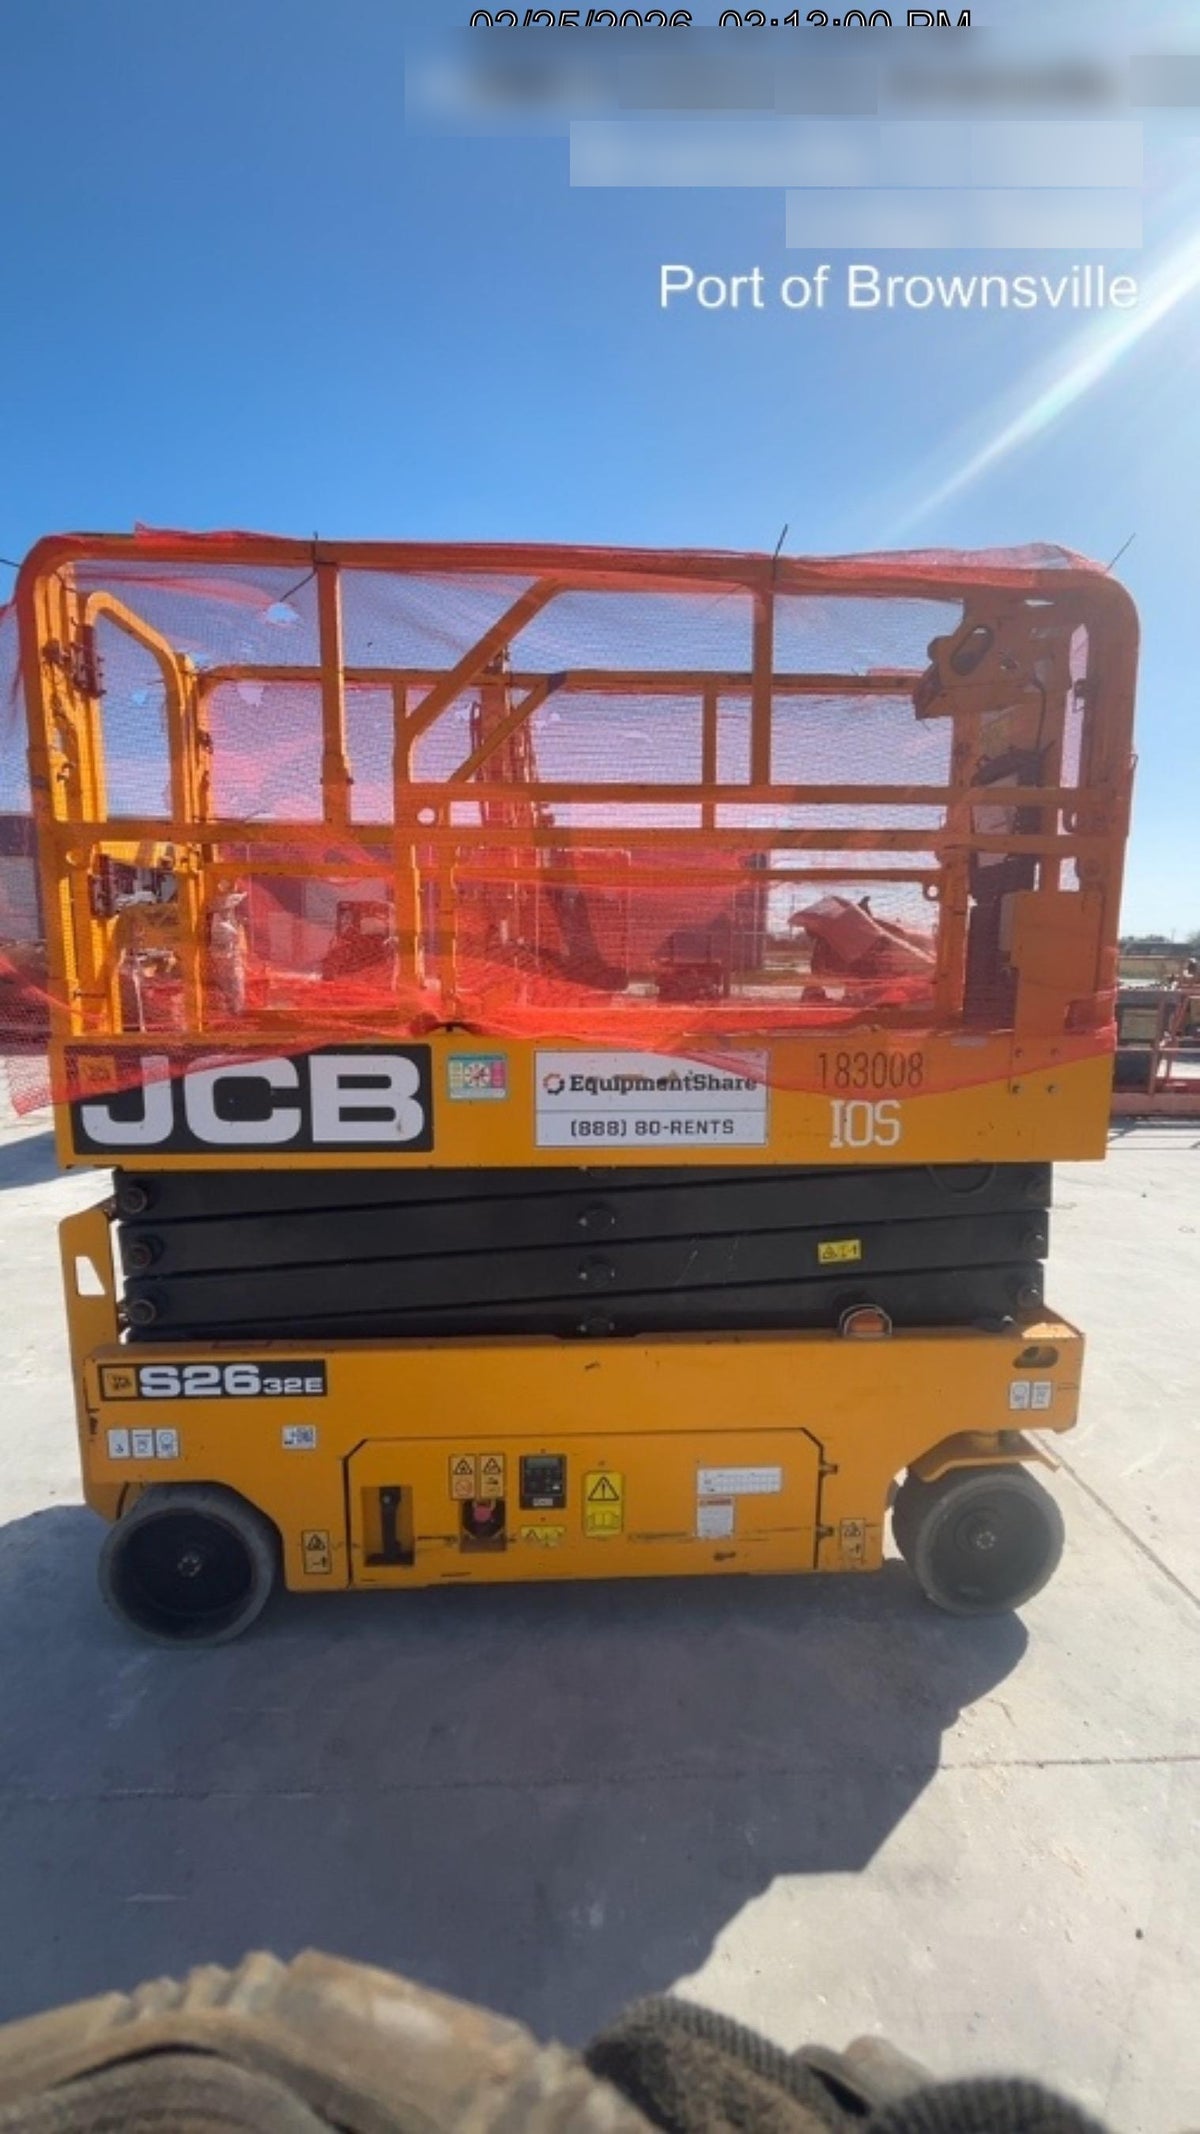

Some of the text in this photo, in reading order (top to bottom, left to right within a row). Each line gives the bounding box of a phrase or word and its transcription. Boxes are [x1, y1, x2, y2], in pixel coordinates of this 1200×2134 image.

[569, 1072, 757, 1095] EquipmentShare
[818, 1051, 923, 1089] 183008
[81, 1055, 424, 1144] JCB
[571, 1119, 735, 1137] (888) 80-RENTS
